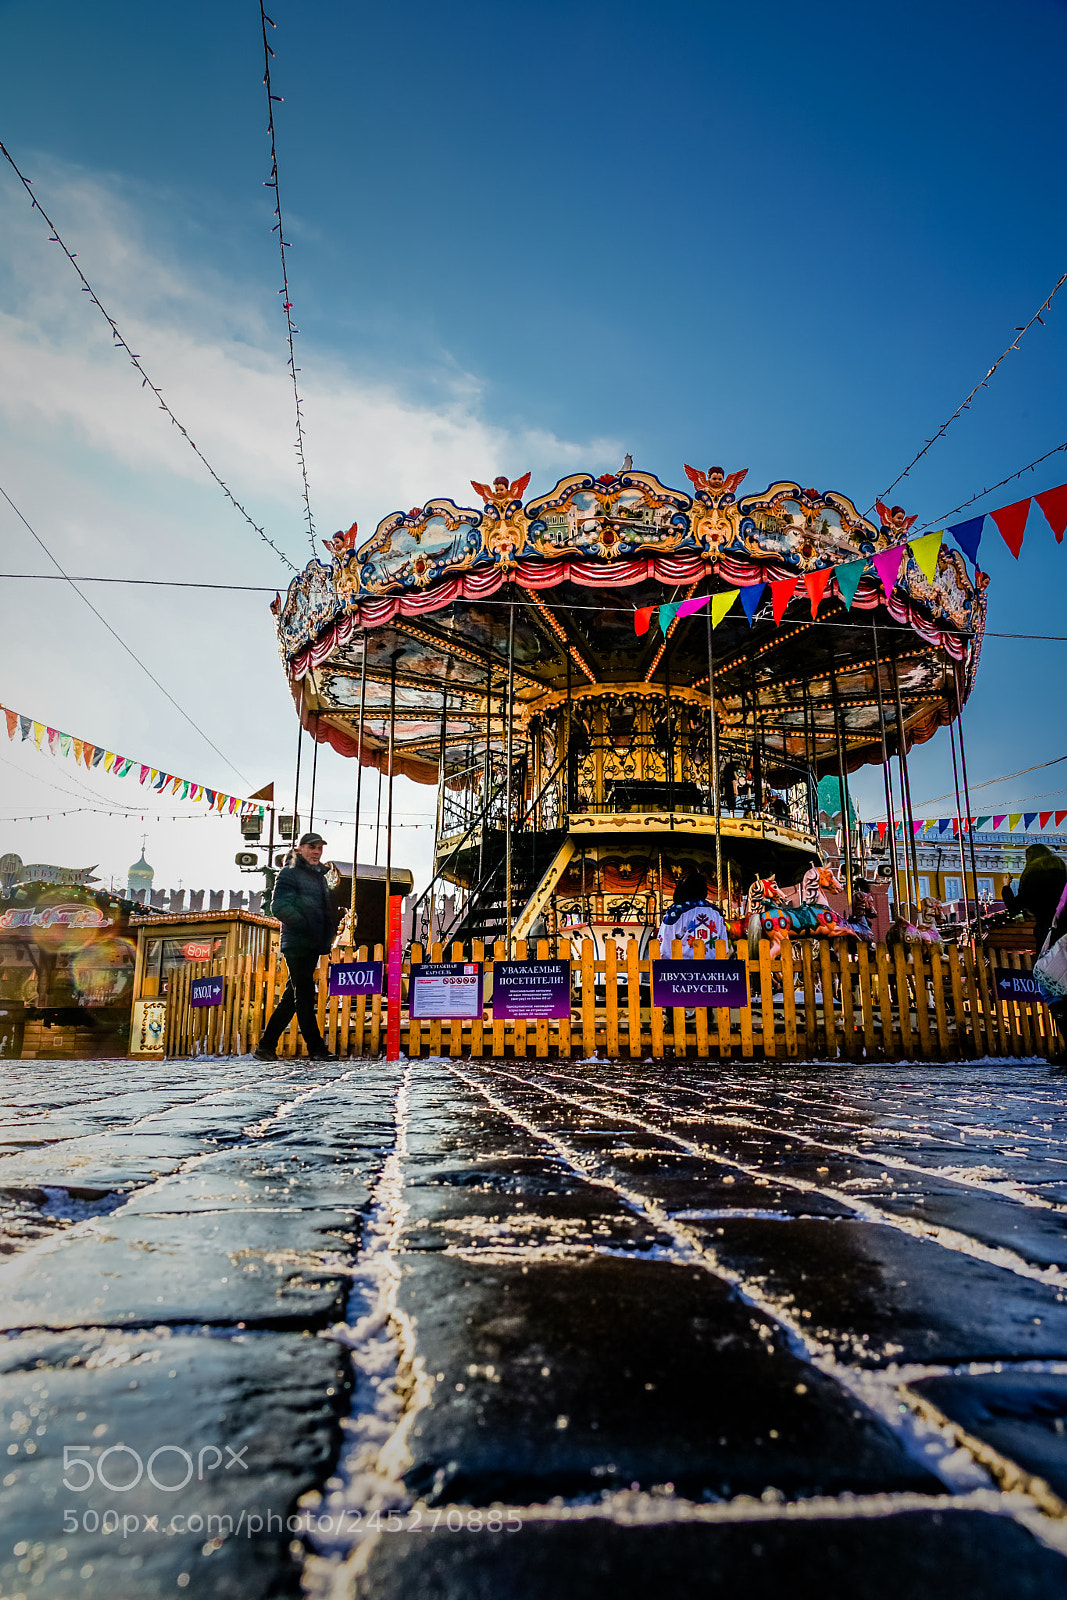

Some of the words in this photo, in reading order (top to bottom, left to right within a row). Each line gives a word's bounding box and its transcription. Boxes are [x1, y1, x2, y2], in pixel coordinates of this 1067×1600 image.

[25, 869, 82, 882] ЧЕБУРЕКИ
[501, 965, 562, 975] УВАЖАЕМЫЕ
[337, 968, 375, 989] ВХОД
[499, 976, 564, 986] ПОСЕТИТЕЛИ!
[658, 972, 740, 982] ДВУХЭТАЖНАЯ
[672, 984, 729, 994] КАРУСЕЛЬ
[1013, 978, 1042, 994] ВХОД
[193, 985, 212, 1000] ВХОД
